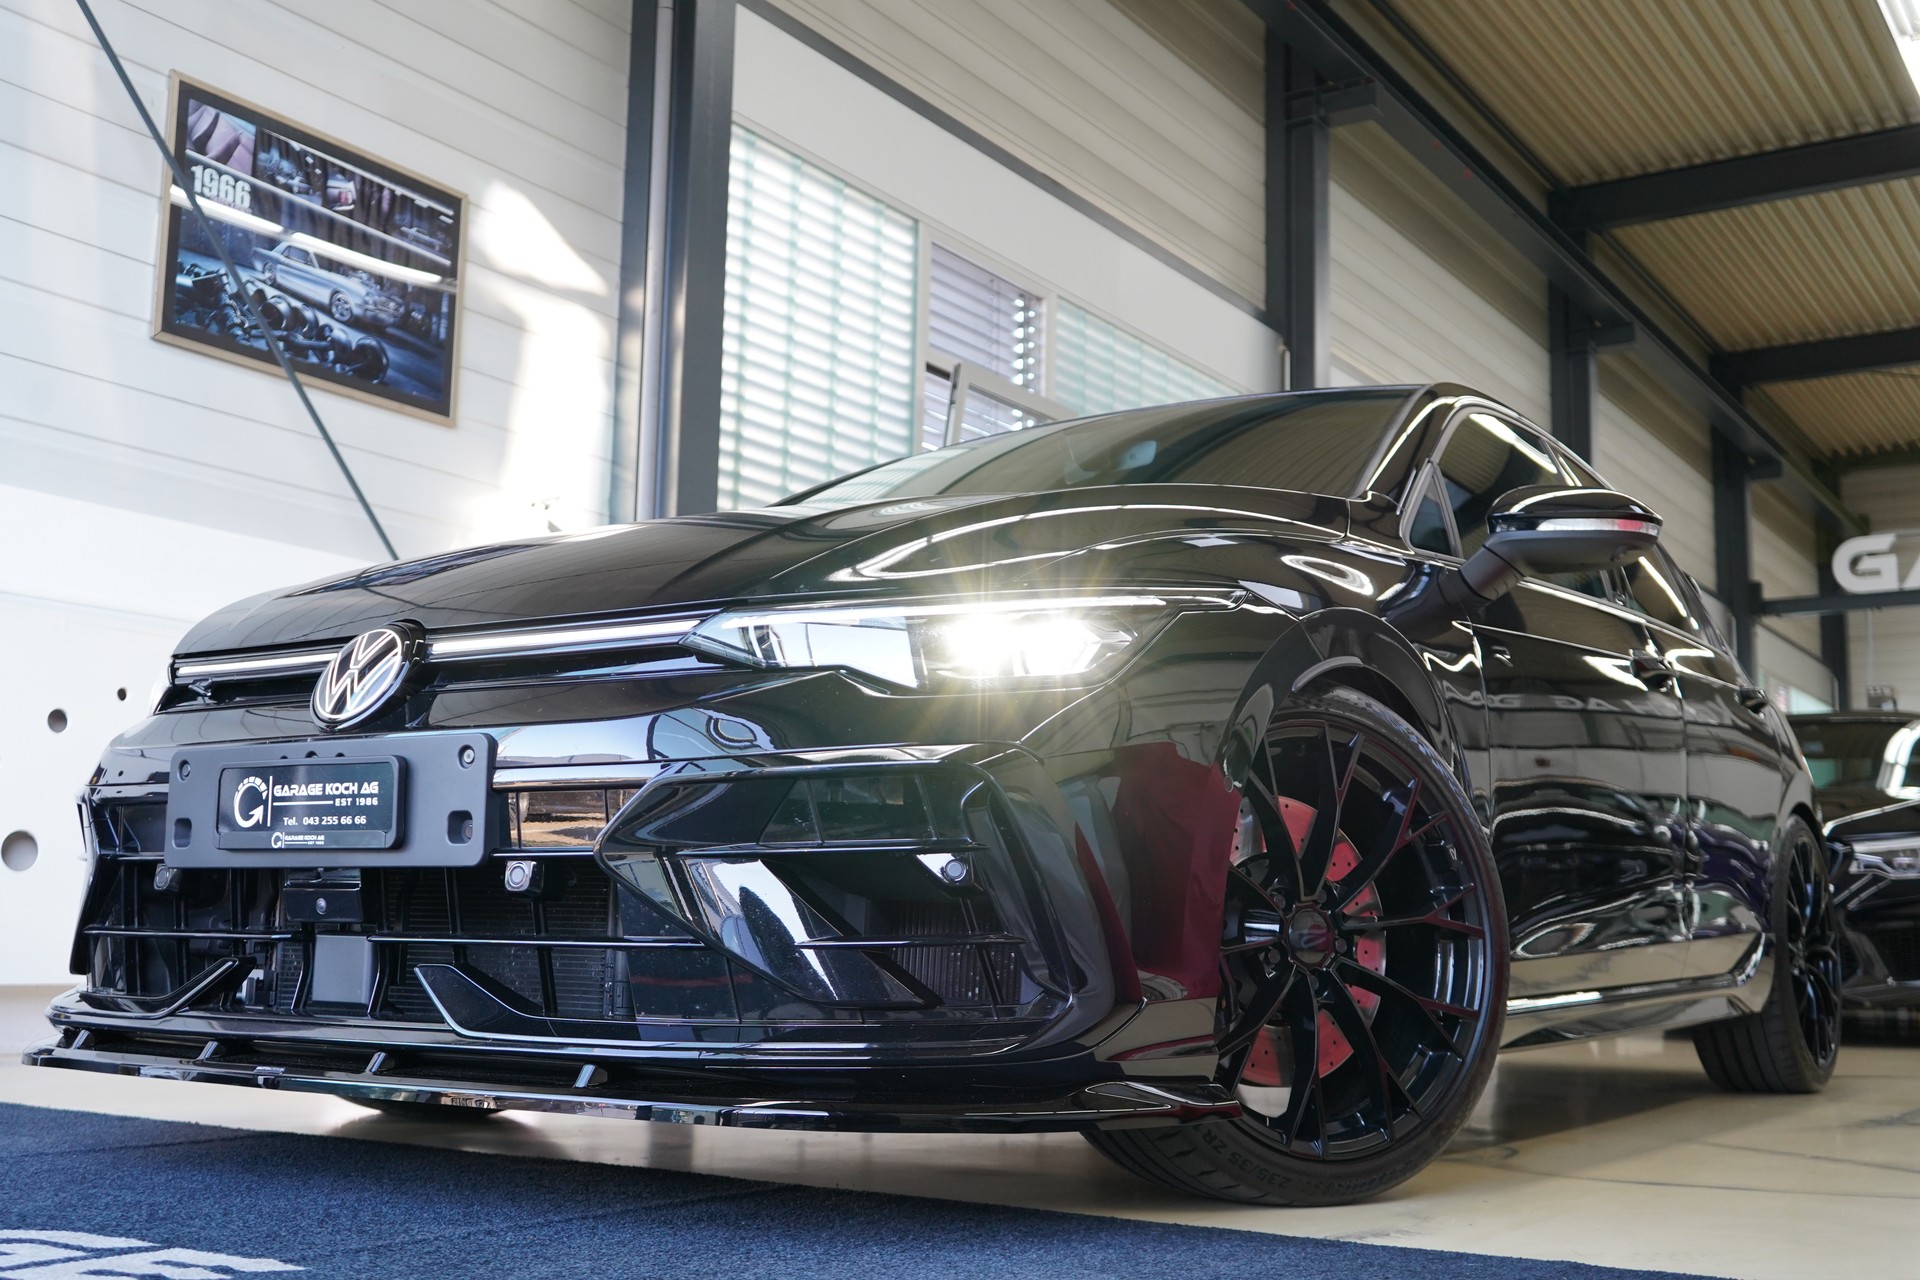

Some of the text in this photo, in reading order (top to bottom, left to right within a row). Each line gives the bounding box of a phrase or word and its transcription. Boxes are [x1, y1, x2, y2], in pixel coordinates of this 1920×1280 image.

[190, 164, 252, 209] 1966
[1831, 532, 1920, 594] G
[273, 781, 379, 797] GARAGE KOCH AG
[334, 797, 378, 807] EST 1986
[283, 815, 367, 825] Tel. 043 255 66 66
